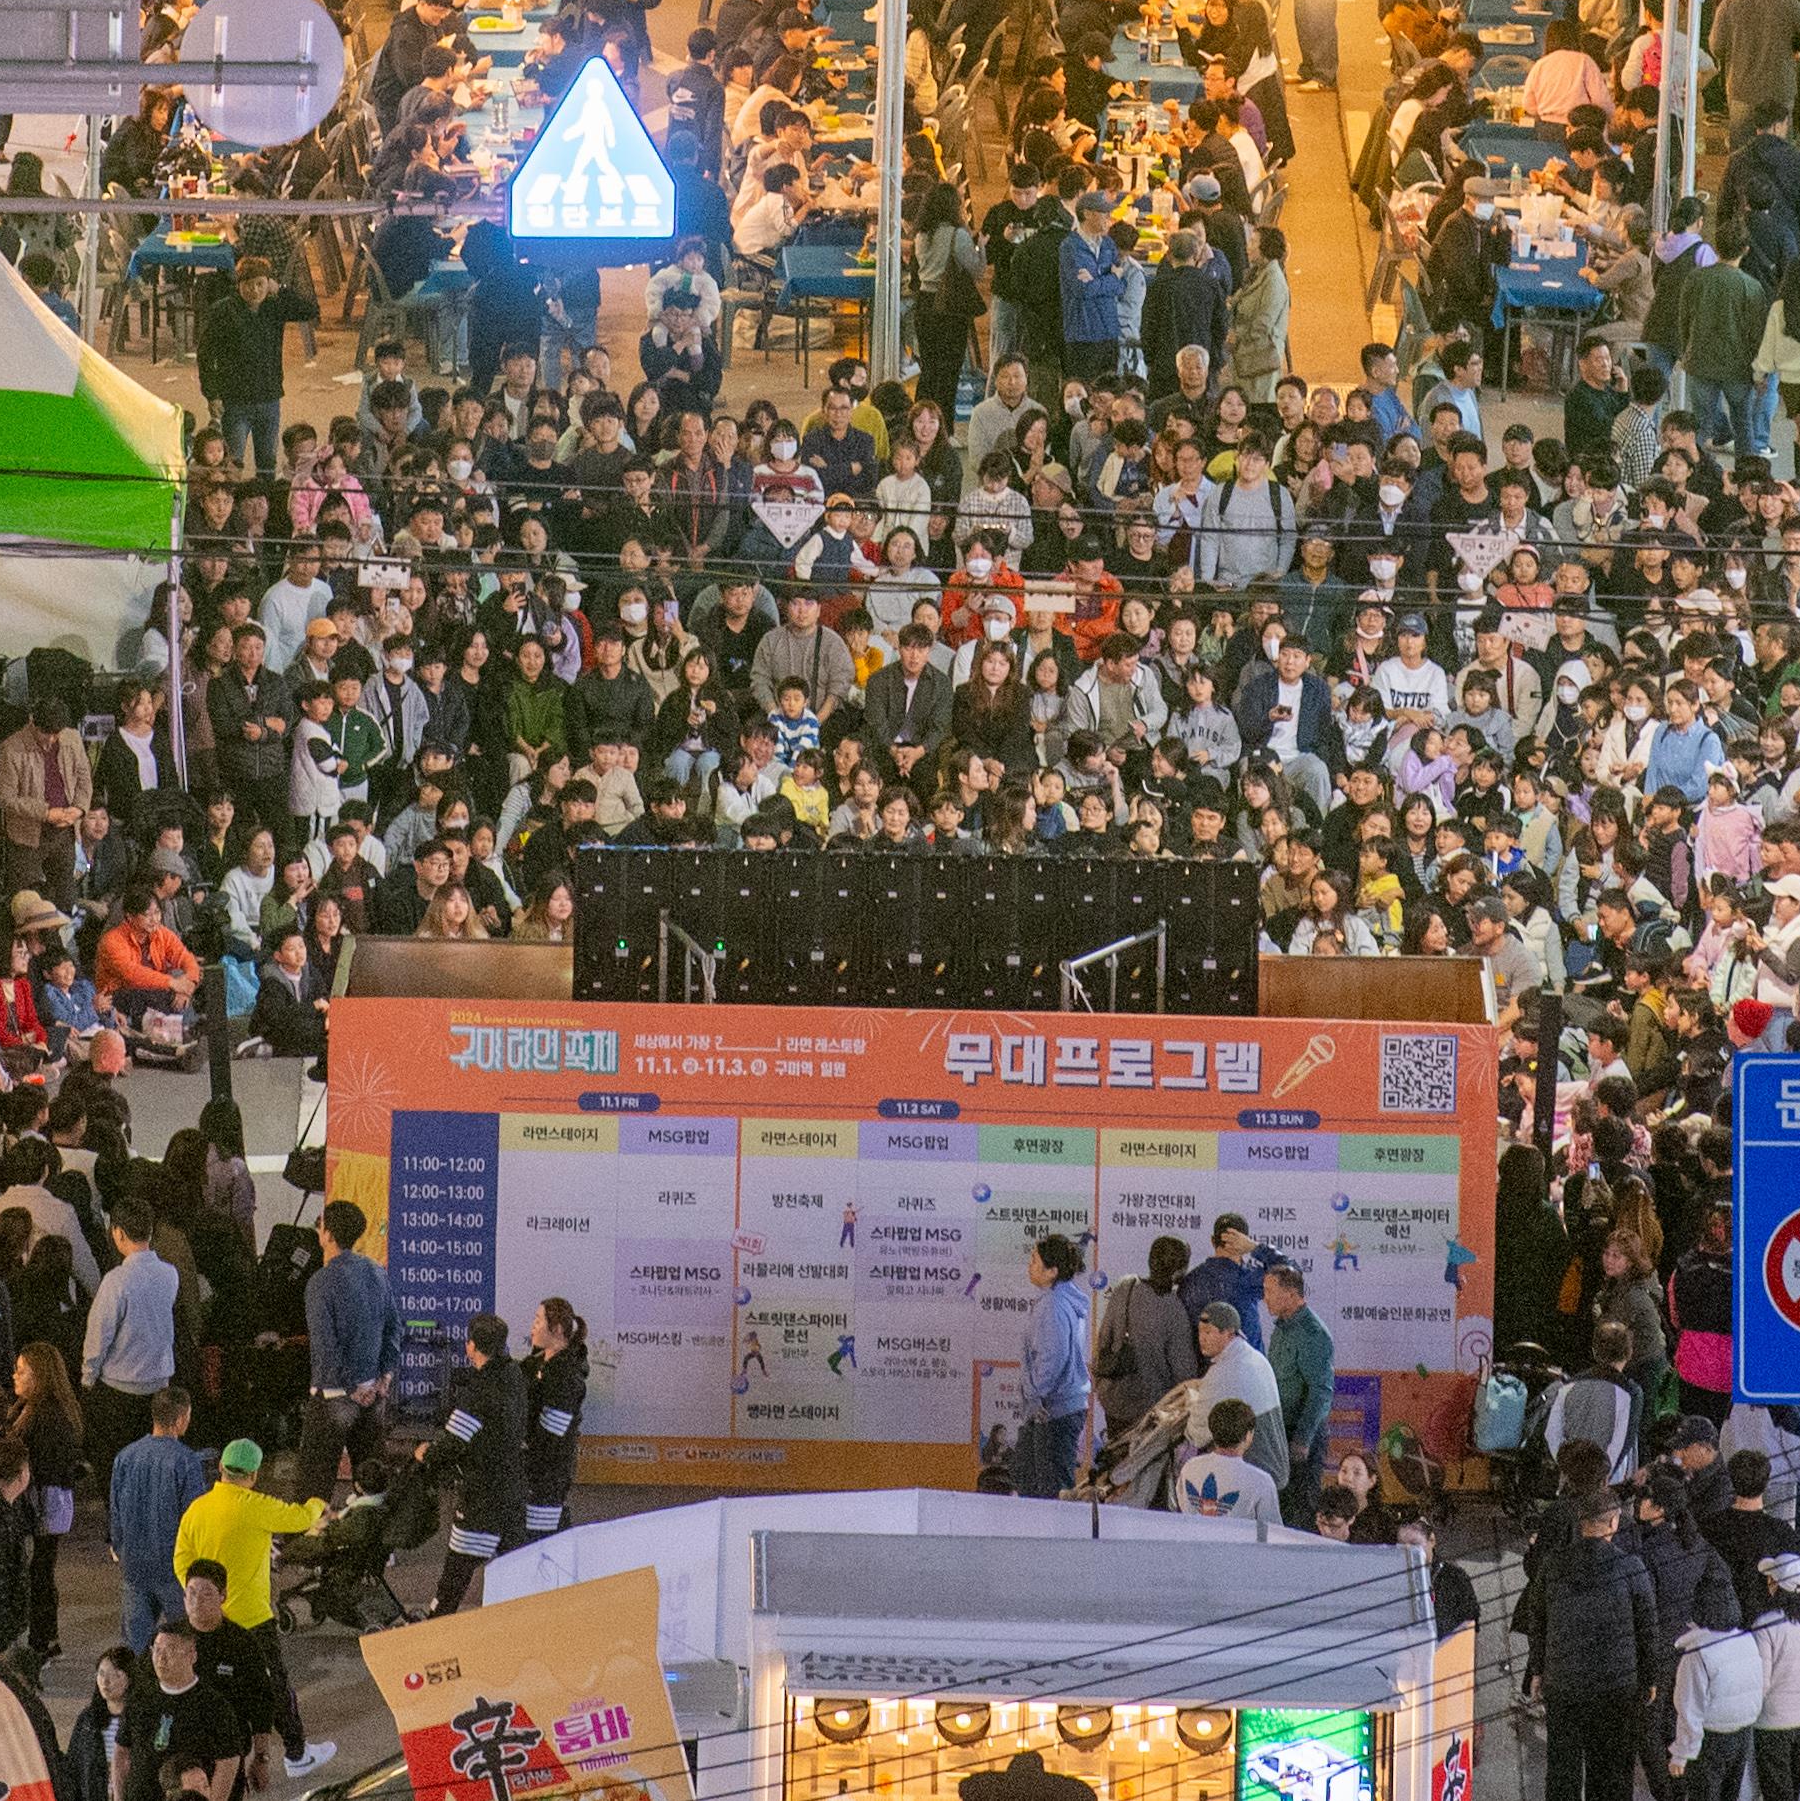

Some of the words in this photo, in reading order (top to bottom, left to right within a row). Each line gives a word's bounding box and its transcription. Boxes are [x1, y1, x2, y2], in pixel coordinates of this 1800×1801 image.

[774, 1061, 814, 1077] 구미역
[944, 1033, 1261, 1095] 무대프로그램
[621, 1096, 640, 1109] FRI
[920, 1103, 942, 1116] SAT
[1255, 1113, 1278, 1126] 11.3
[1279, 1114, 1304, 1127] SUN
[522, 1125, 599, 1142] 라면스테이지
[648, 1128, 710, 1145] MSG팝업
[760, 1131, 838, 1148] 라면스테이지
[887, 1135, 950, 1151] MSG팝업
[1013, 1137, 1064, 1155] 후면광장
[1119, 1141, 1197, 1159] 라면스테이지
[1247, 1145, 1310, 1161] MSG팝업
[402, 1155, 486, 1172] 11:00~12:00
[402, 1184, 485, 1201] 12:00~13:00
[658, 1191, 698, 1206] 라퀴즈
[1118, 1192, 1196, 1209] 가왕경연대회
[897, 1197, 937, 1212] 라퀴즈
[401, 1212, 484, 1229] 13:00~14:00
[984, 1206, 1089, 1224] 스트릿댄스파이터
[1257, 1206, 1297, 1222] 라퀴즈
[1346, 1207, 1451, 1224] 스트릿댄스파이터
[526, 1216, 591, 1233] 라크레이션
[1384, 1223, 1411, 1240] 예선
[870, 1226, 921, 1243] 스타팝업
[924, 1226, 963, 1242] MSG
[401, 1240, 483, 1256] 14:00~15:00
[401, 1268, 483, 1285] 15:00~16:00
[629, 1265, 682, 1282] 스타팝업
[684, 1265, 722, 1282] MSG
[869, 1265, 921, 1281] 스타팝업
[923, 1266, 962, 1281] MSG
[401, 1296, 483, 1312] 16:00~17:00
[745, 1312, 848, 1329] 스트릿댄스파이터
[1340, 1306, 1452, 1323] 생활예술인문화공연
[616, 1331, 683, 1348] MSG버스킹
[876, 1336, 952, 1353] MSG버스킹
[787, 1404, 840, 1421] 스테이지
[426, 1663, 462, 1687] 농심
[553, 1705, 633, 1757] 툼바
